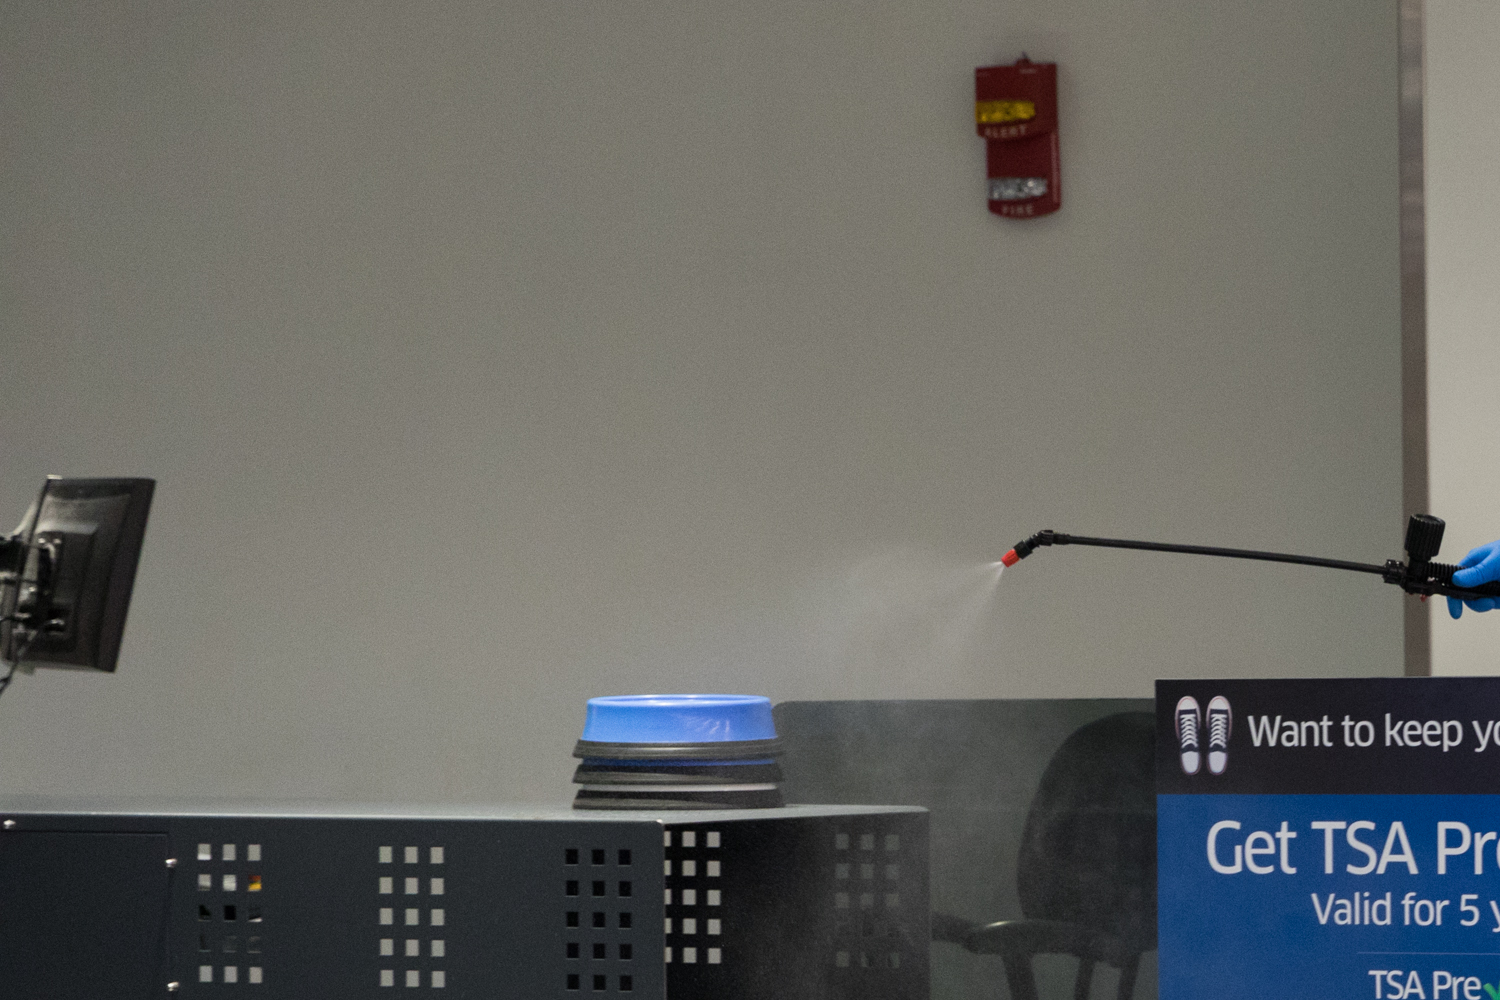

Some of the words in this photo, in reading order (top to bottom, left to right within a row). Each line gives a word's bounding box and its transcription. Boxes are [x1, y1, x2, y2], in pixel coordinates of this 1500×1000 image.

[1247, 715, 1334, 747] Want
[1341, 714, 1375, 747] to
[1384, 712, 1463, 752] keep
[1206, 820, 1297, 875] Get
[1311, 820, 1419, 875] TSA
[1311, 892, 1391, 926] Valid
[1401, 892, 1450, 927] for
[1460, 894, 1480, 927] 5
[1368, 970, 1426, 1000] TSA
[1432, 970, 1482, 1000] Pre
